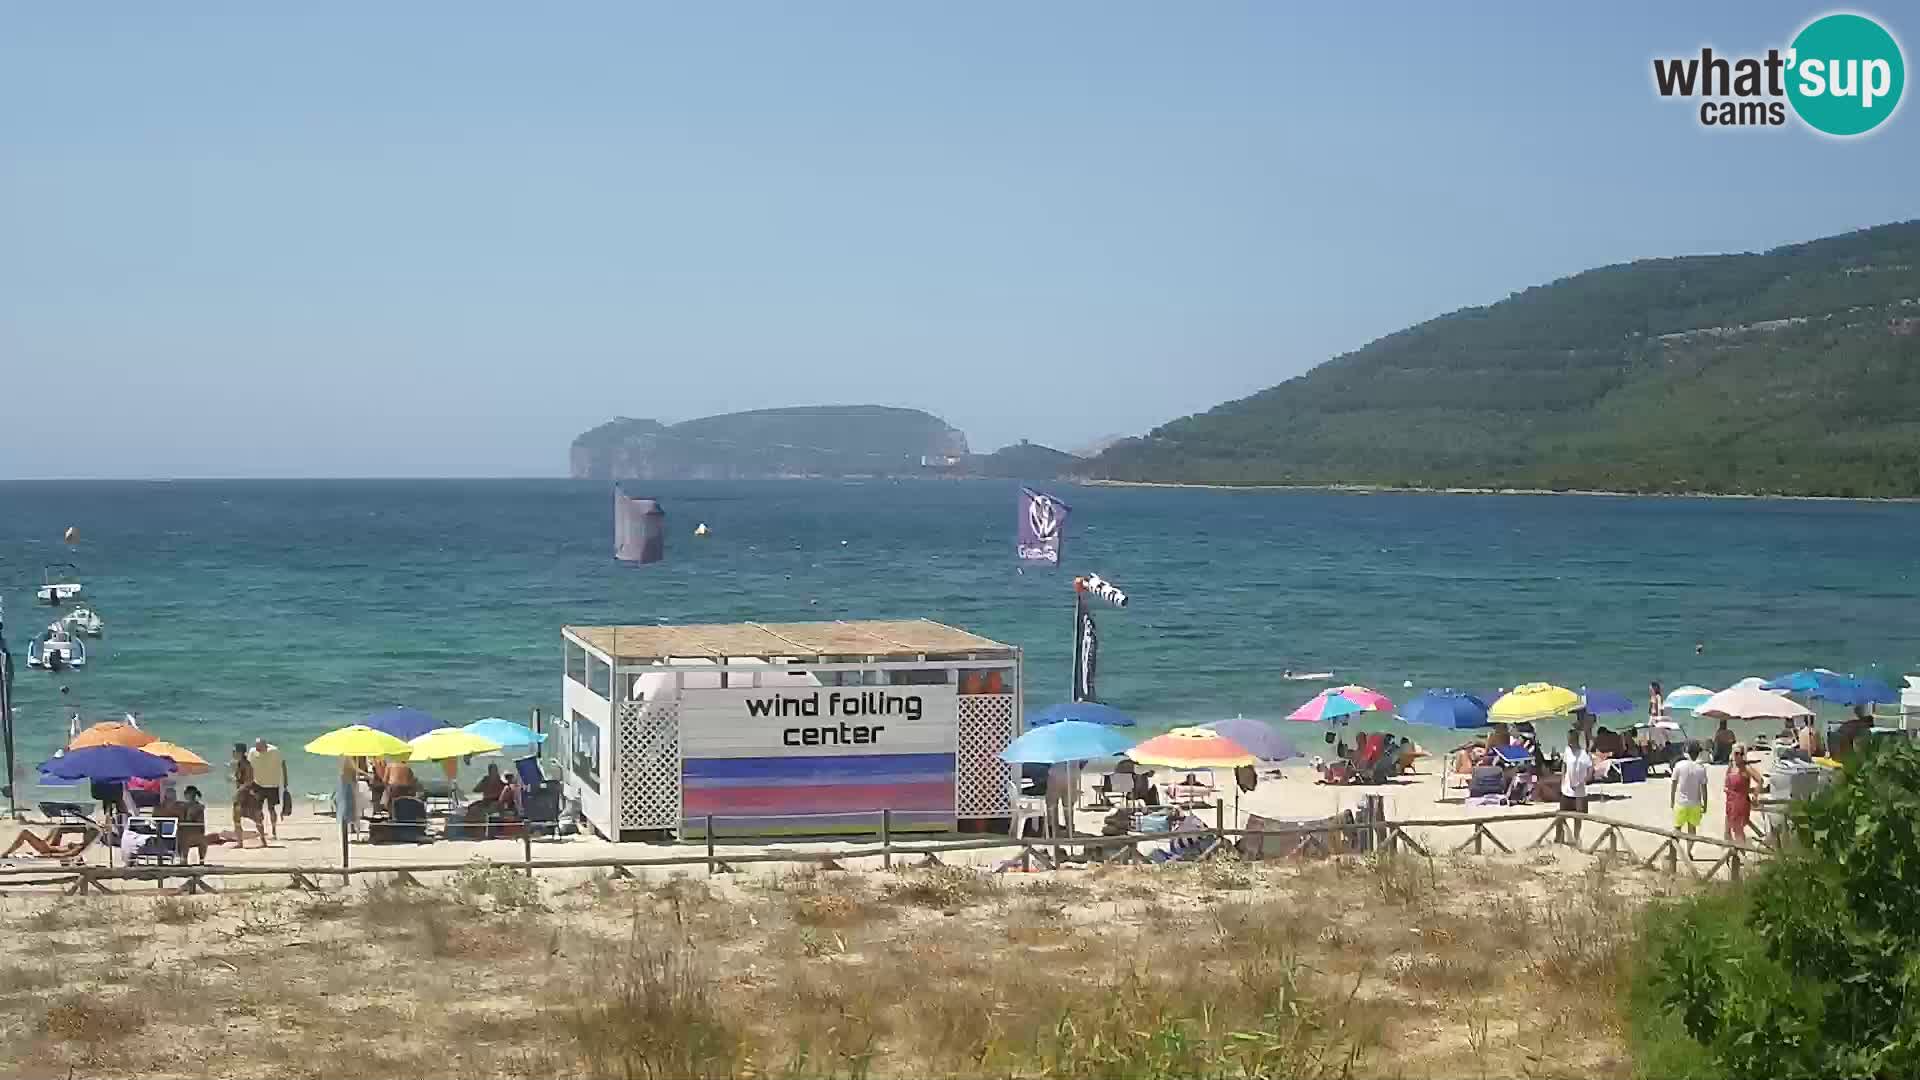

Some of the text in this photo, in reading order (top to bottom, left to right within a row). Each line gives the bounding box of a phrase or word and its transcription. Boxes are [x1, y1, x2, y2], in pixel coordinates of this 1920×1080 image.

[745, 691, 922, 721] wind foiling
[783, 722, 885, 746] center
